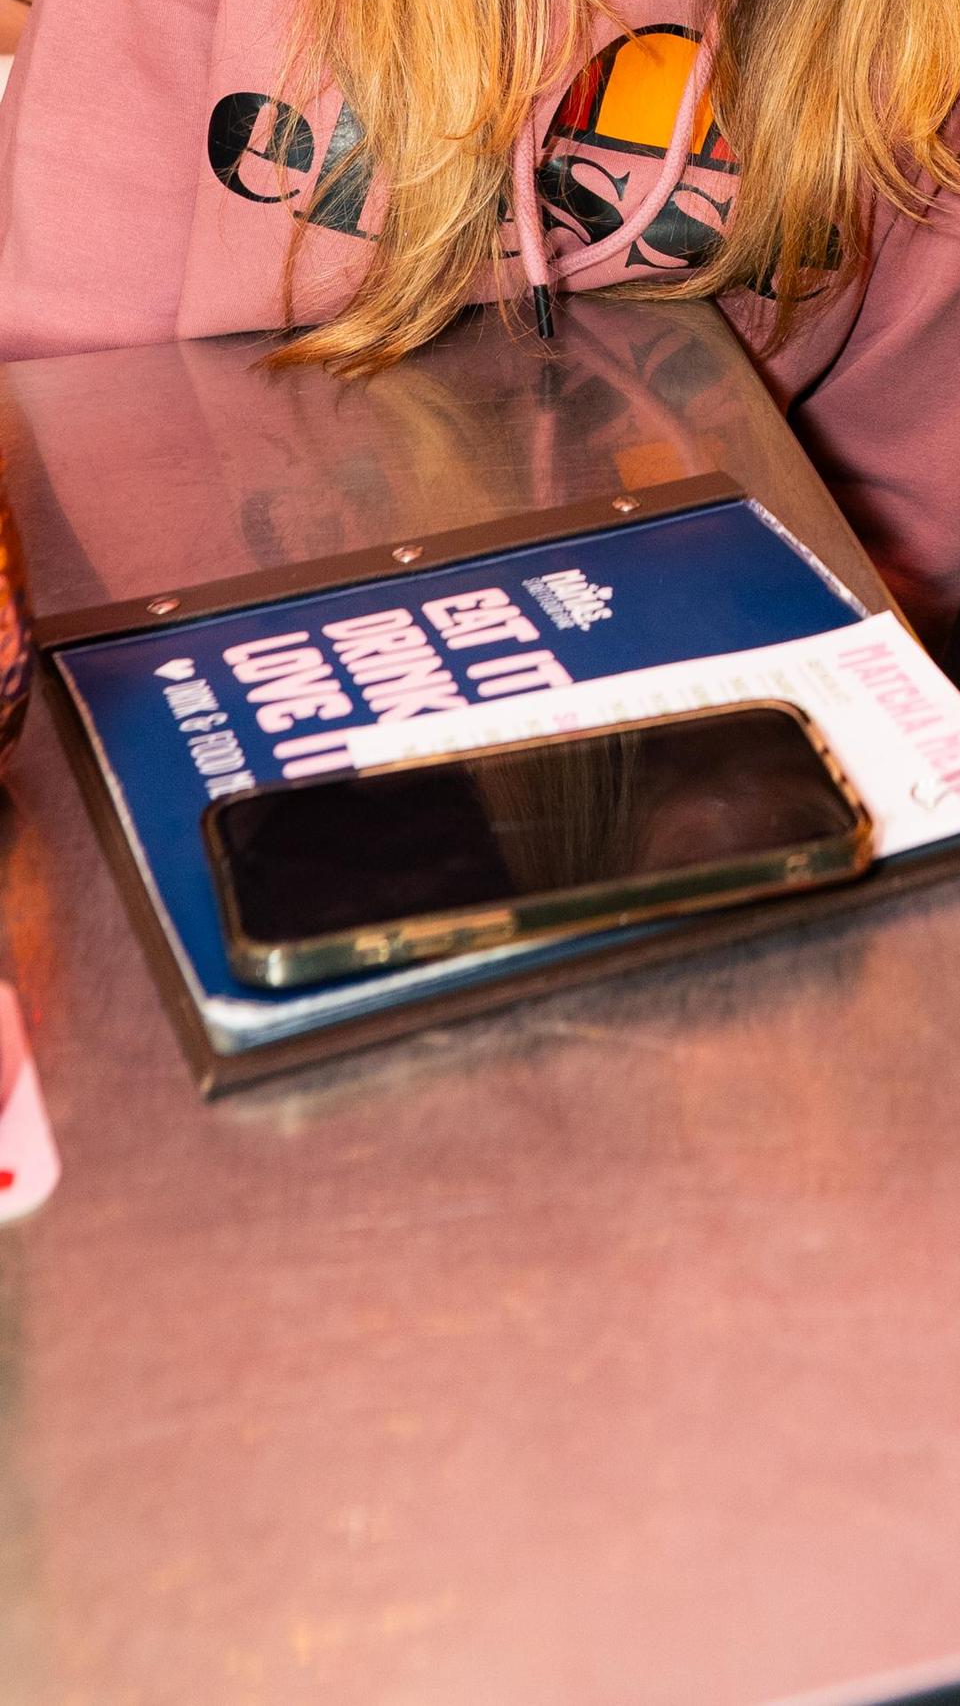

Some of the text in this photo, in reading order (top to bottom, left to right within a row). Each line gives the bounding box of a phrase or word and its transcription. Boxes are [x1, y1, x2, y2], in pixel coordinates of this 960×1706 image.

[421, 587, 541, 650] EAT
[222, 630, 353, 734] LOVE
[322, 607, 470, 724] DRINK
[466, 649, 574, 698] IT
[838, 641, 943, 734] MATCHA
[187, 729, 246, 776] FOOD
